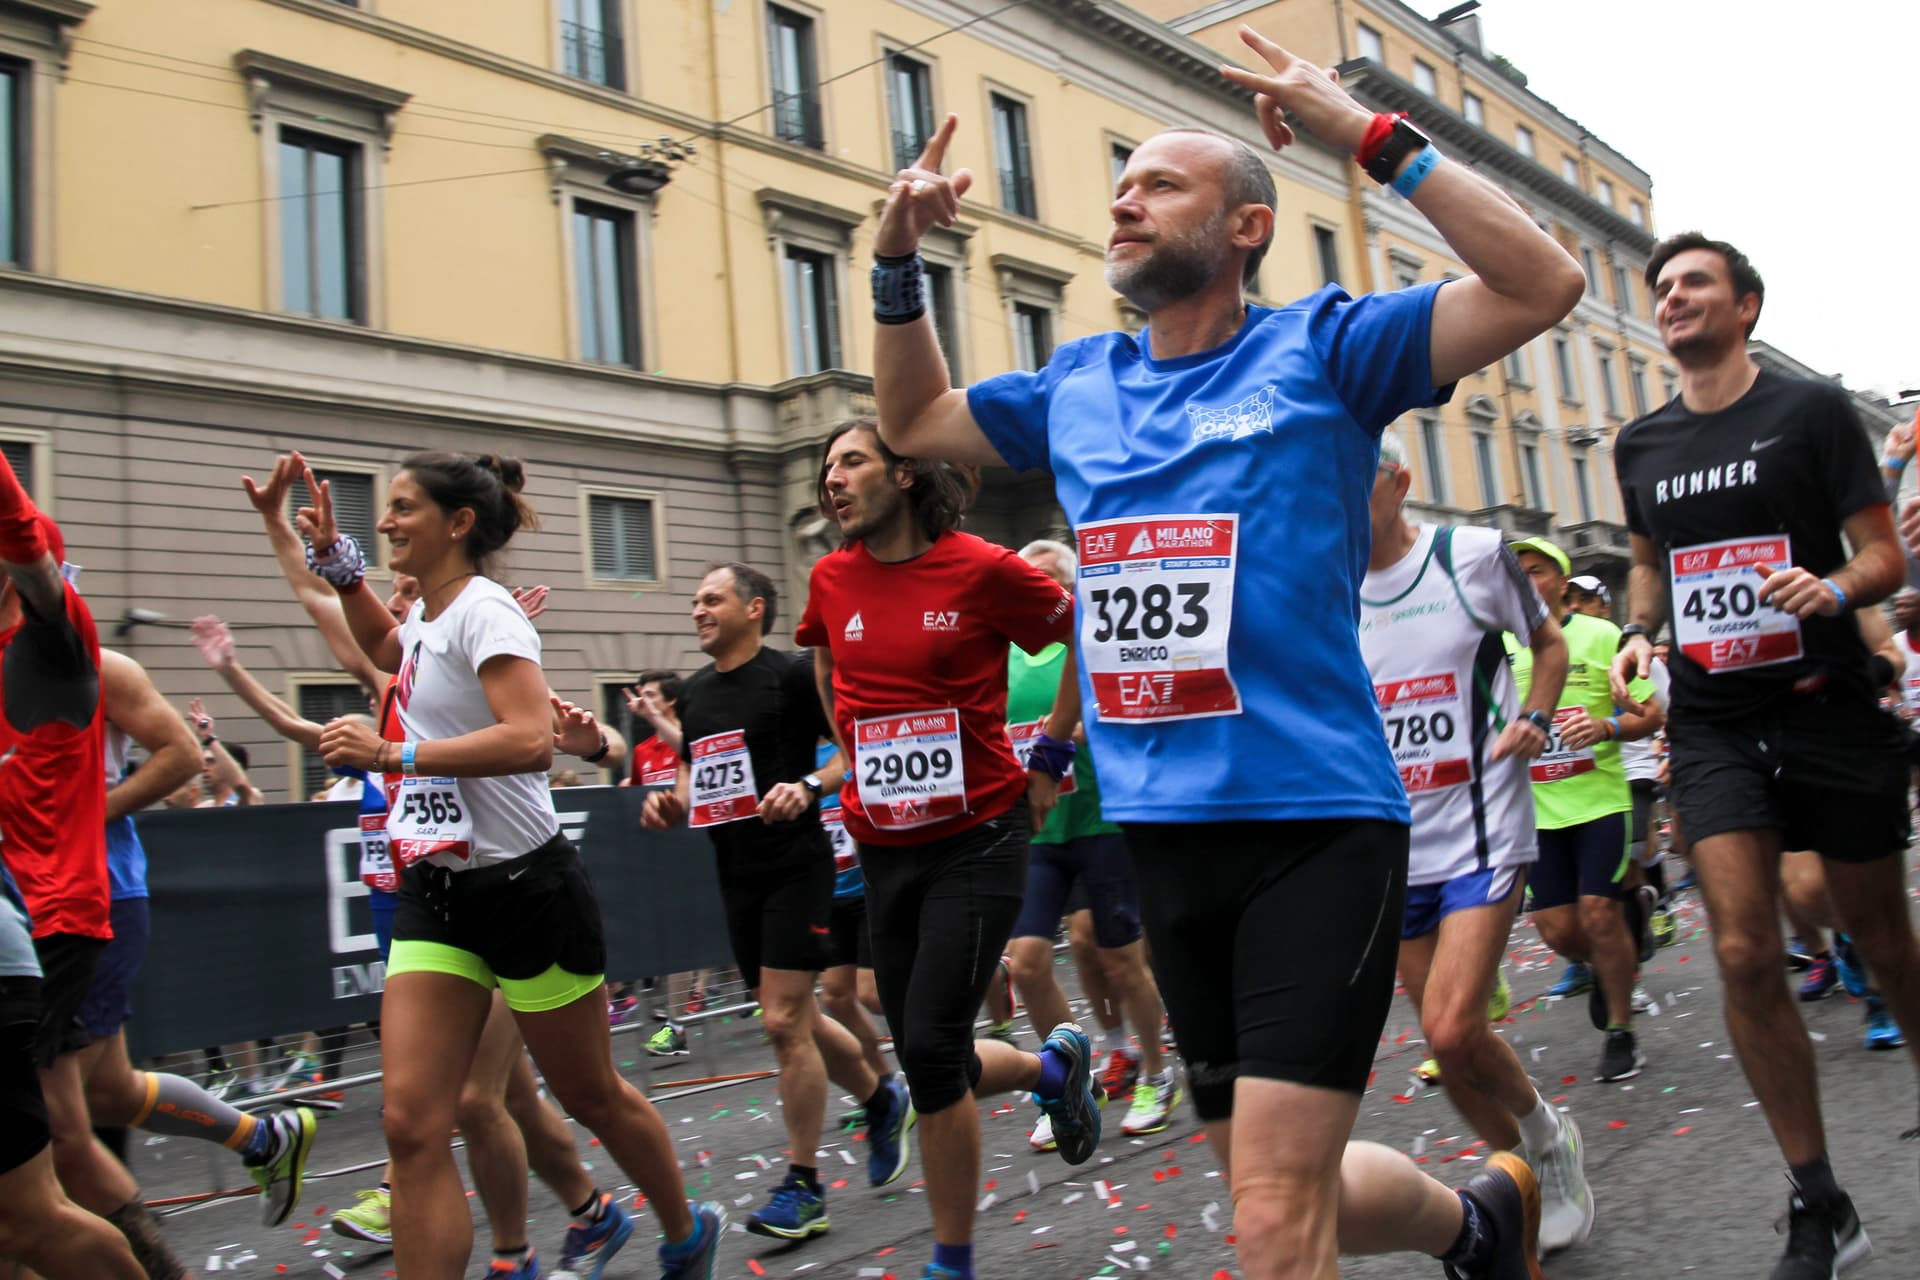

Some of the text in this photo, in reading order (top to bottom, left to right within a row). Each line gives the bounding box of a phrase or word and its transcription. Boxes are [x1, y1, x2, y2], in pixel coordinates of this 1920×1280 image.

[1656, 460, 1757, 504] RUNNER
[1085, 527, 1213, 553] EA7 MILANO
[1156, 538, 1213, 549] MARATHON
[923, 611, 960, 627] EA7
[1090, 583, 1210, 642] 3283
[1120, 646, 1168, 662] ENRICO
[1711, 638, 1760, 662] EA7
[1118, 674, 1175, 705] EA7
[1385, 711, 1455, 749] 780
[695, 760, 744, 791] 4273
[864, 748, 953, 787] 2909
[1545, 762, 1574, 777] EA7
[881, 783, 937, 799] GIANPAOLO
[398, 791, 463, 825] F365
[415, 827, 438, 835] SARA
[367, 840, 387, 861] F9
